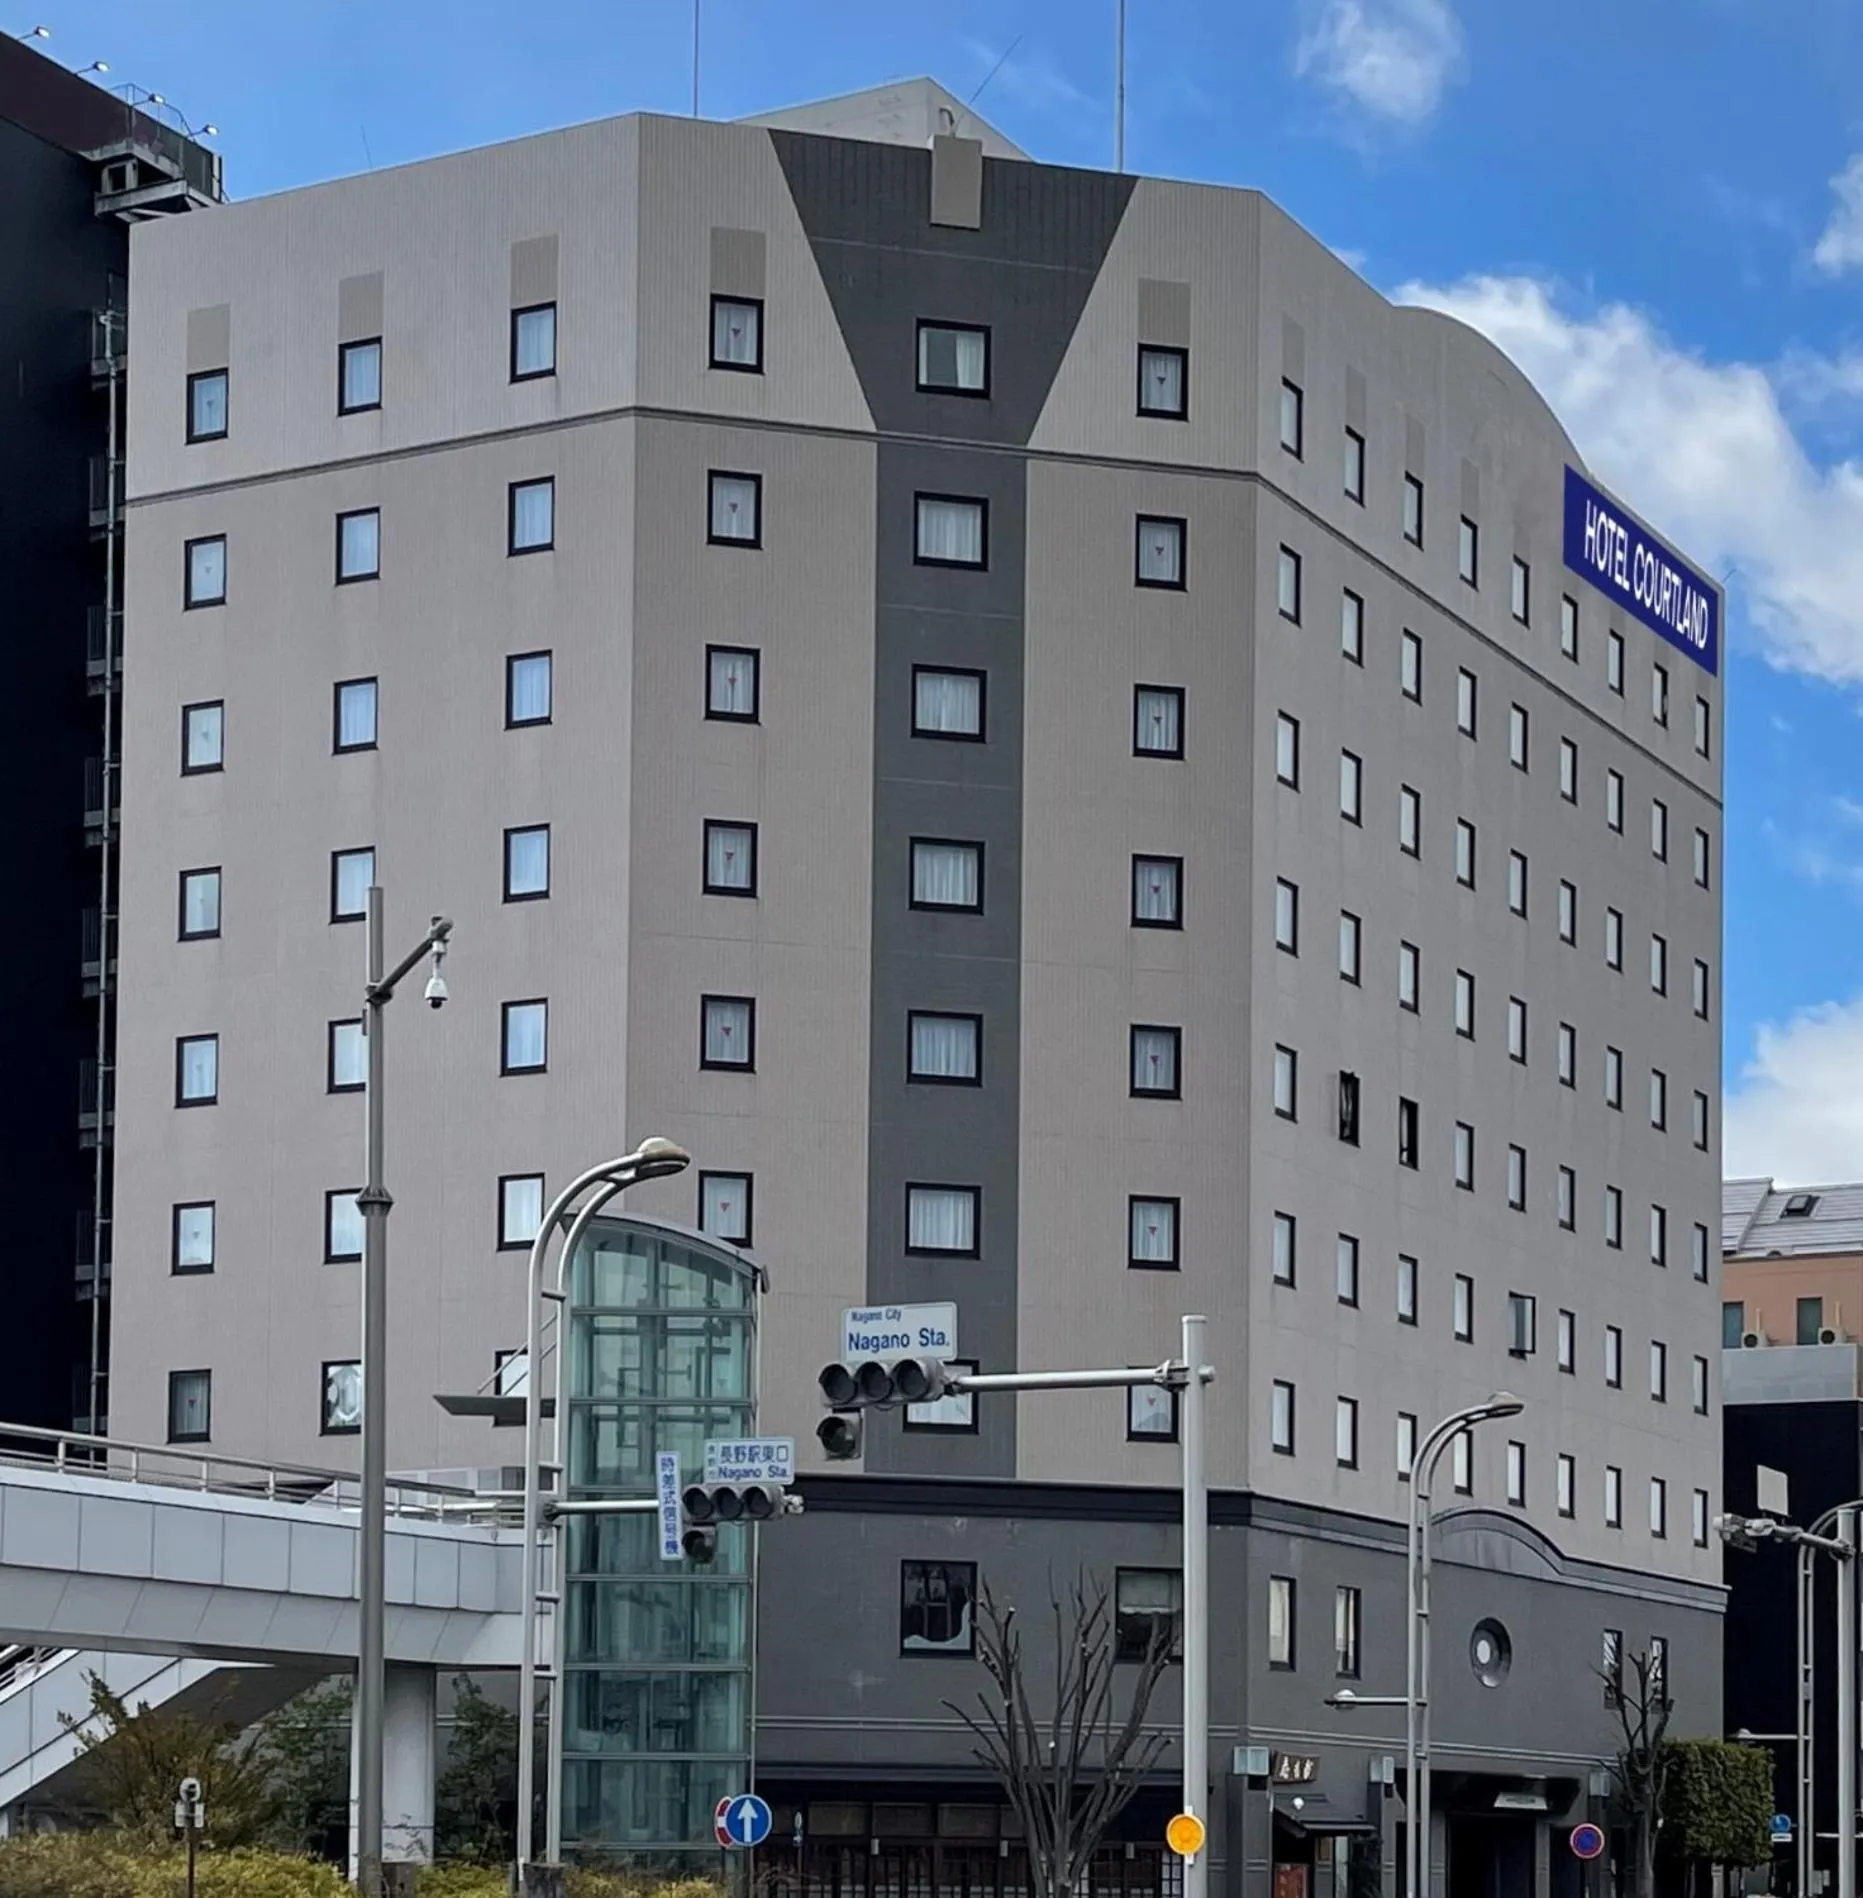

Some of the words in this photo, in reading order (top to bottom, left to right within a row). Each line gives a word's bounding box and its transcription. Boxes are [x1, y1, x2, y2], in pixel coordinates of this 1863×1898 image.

[1584, 499, 1630, 592] HOTEL
[1633, 543, 1709, 649] COURTLAND
[885, 1308, 902, 1322] City
[848, 1332, 910, 1353] Nagano
[919, 1327, 950, 1347] Sta.
[719, 1466, 762, 1480] Nagano
